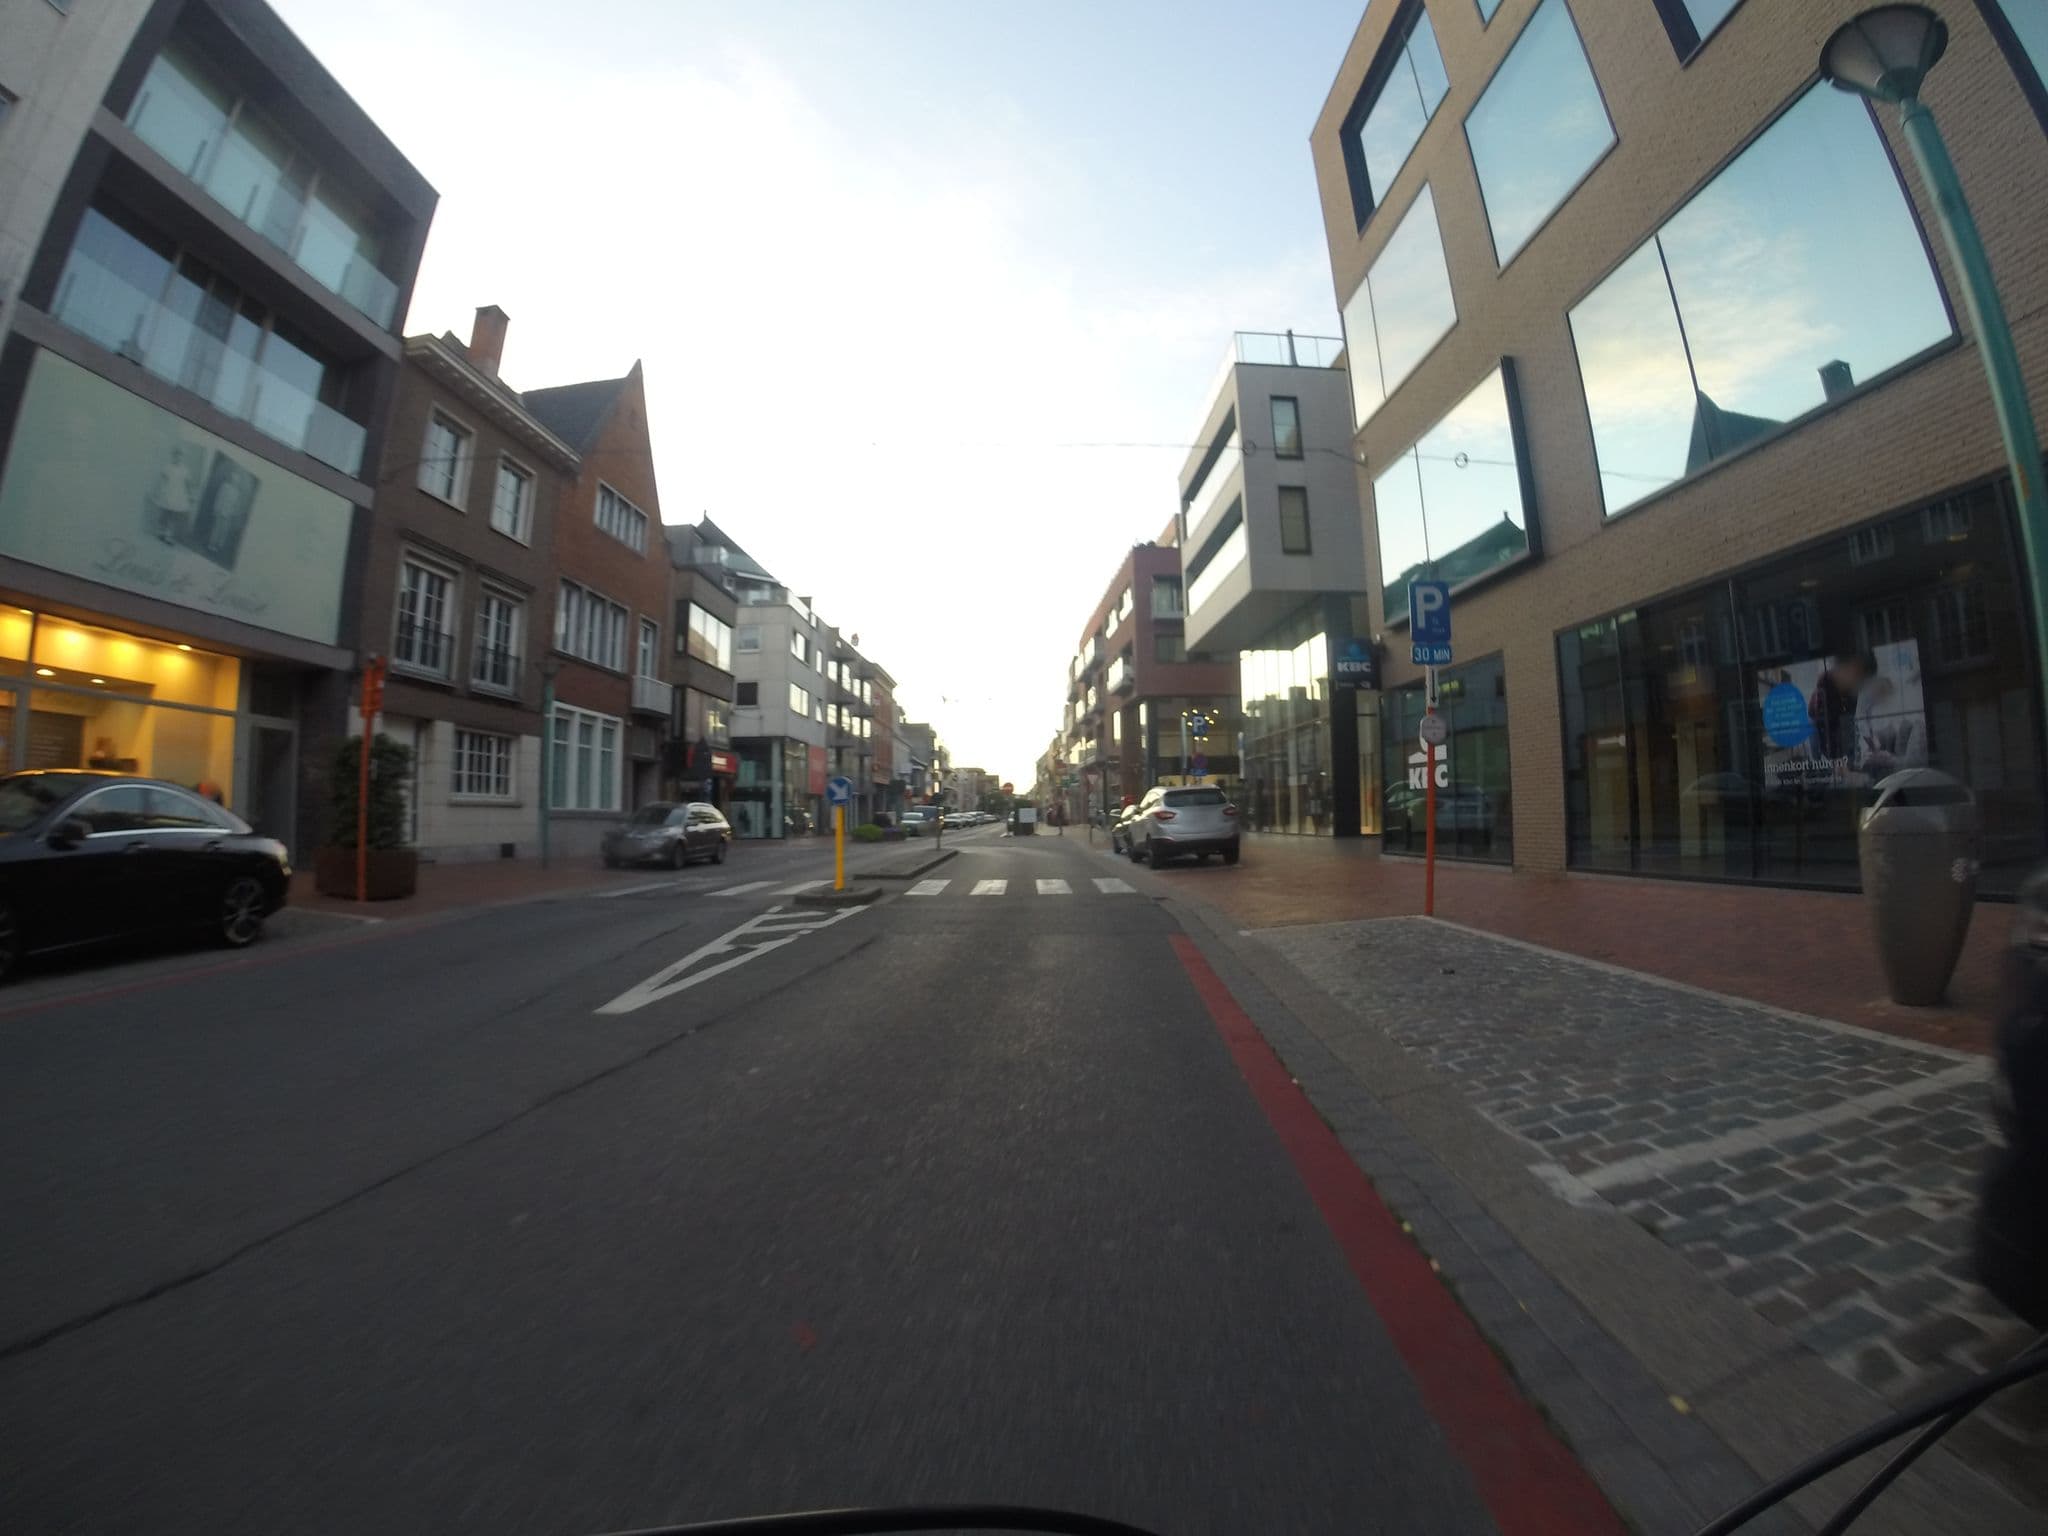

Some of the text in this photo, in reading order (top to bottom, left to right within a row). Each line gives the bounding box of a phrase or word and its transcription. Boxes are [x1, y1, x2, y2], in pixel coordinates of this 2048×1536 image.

[1416, 585, 1443, 628] P
[1414, 647, 1450, 662] 30 MIN
[1337, 662, 1371, 673] KBC
